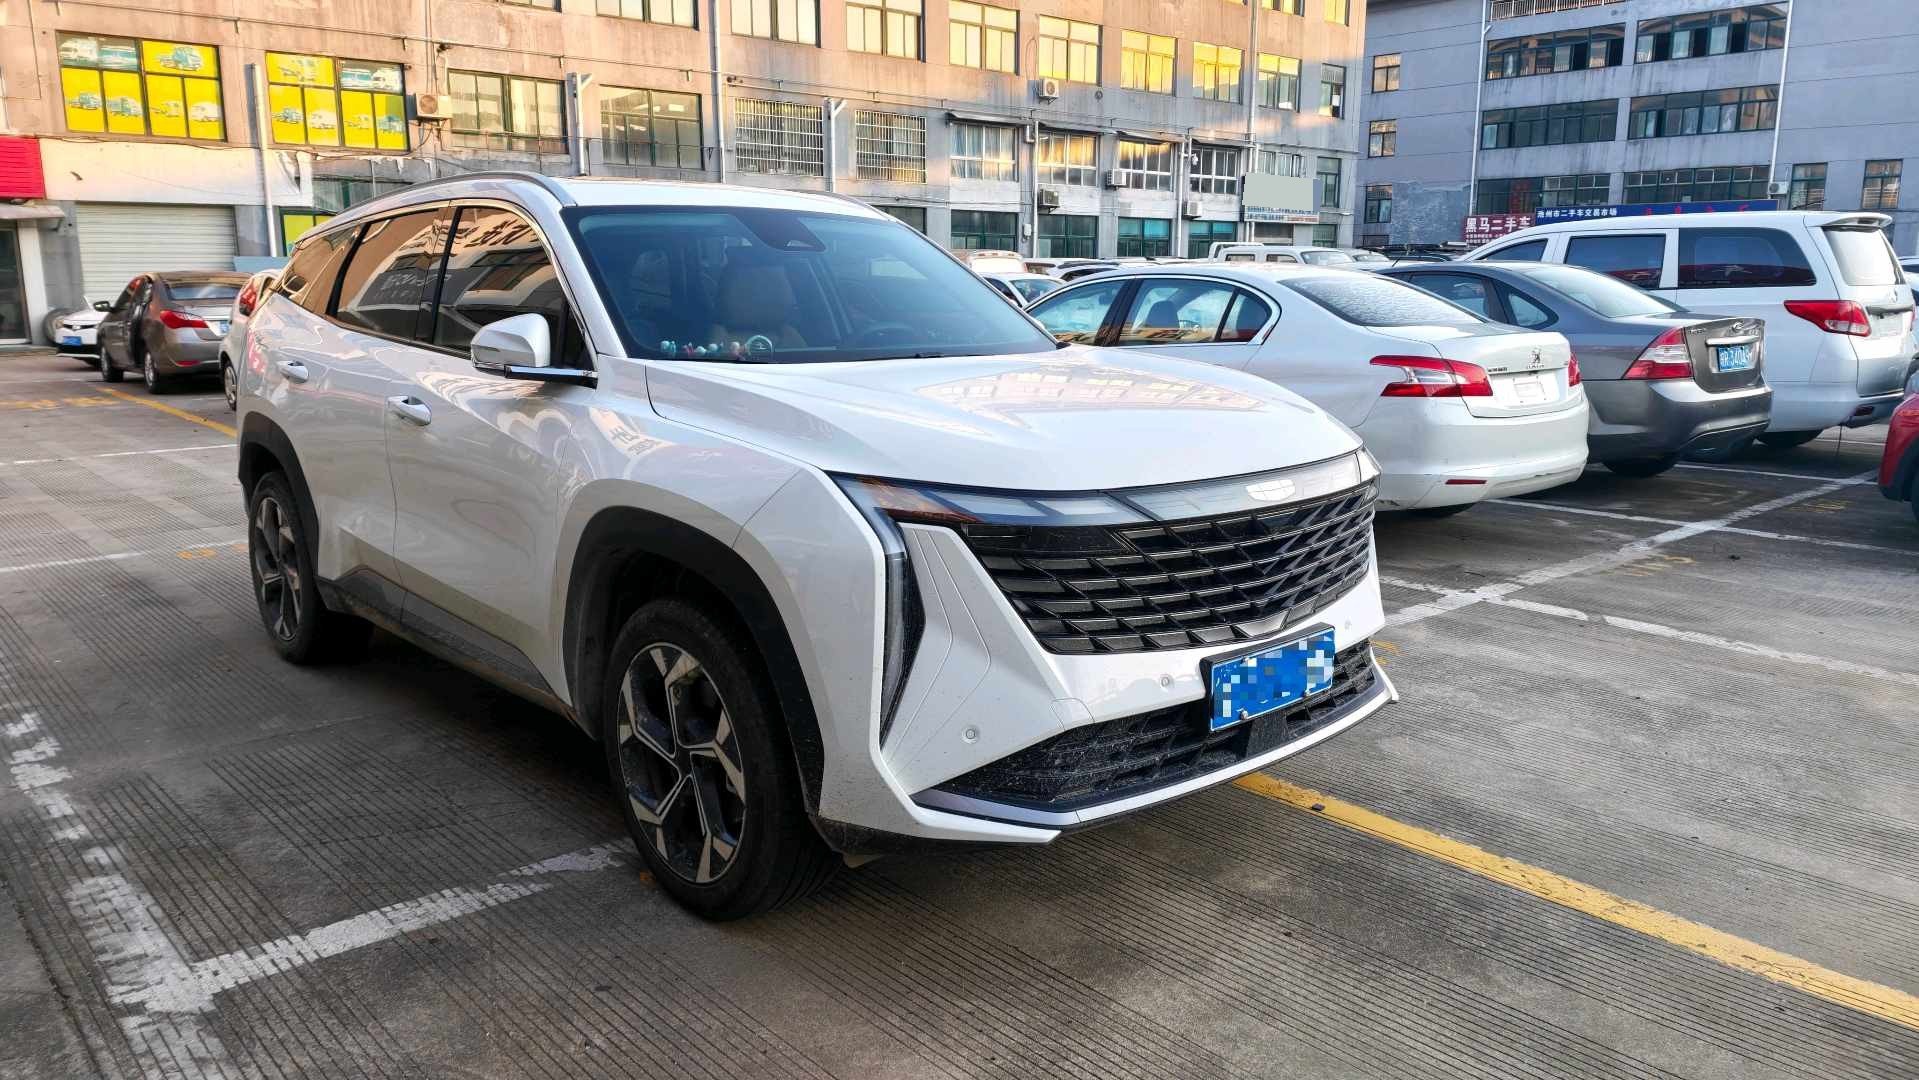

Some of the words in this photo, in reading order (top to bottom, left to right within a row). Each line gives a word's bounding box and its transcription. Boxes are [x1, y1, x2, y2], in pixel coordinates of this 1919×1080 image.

[1465, 216, 1531, 233] 黑马二手车
